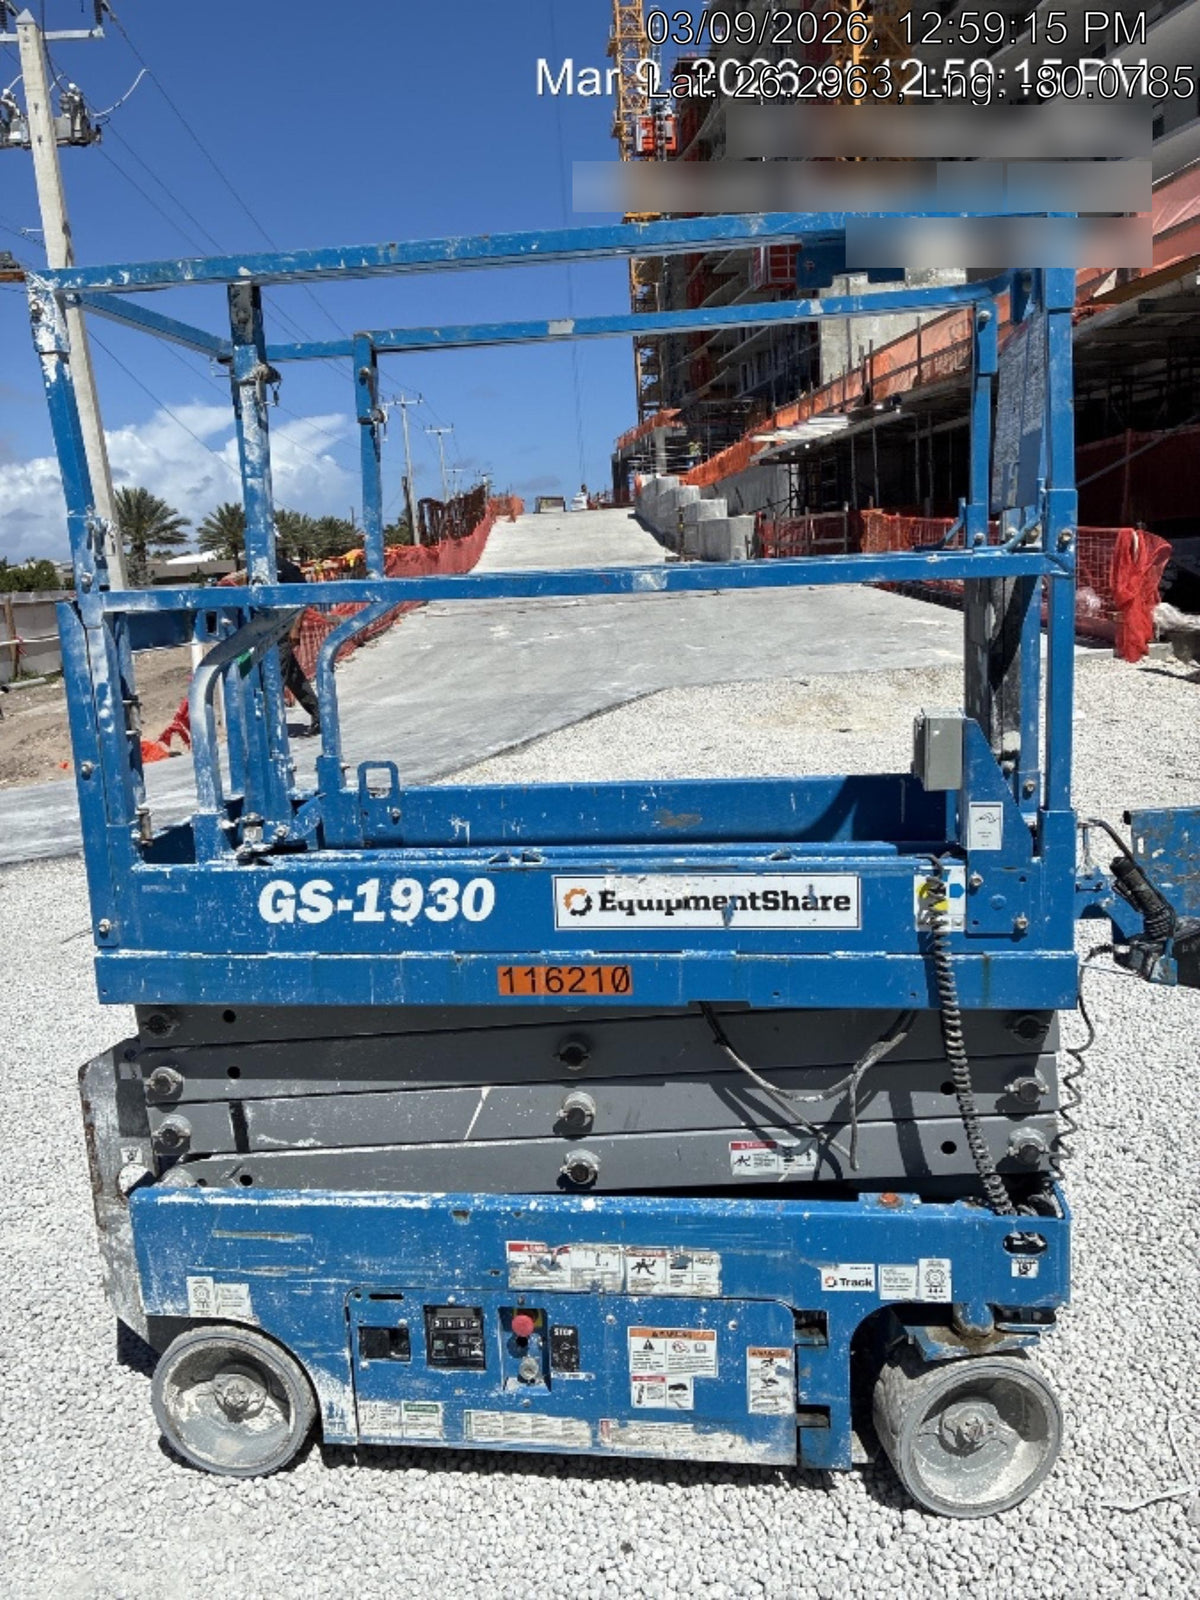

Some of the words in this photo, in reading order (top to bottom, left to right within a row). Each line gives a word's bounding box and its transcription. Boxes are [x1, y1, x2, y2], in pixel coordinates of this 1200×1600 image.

[258, 877, 495, 924] GS-1930
[599, 890, 851, 916] EquipmentShare
[502, 965, 631, 993] 116210
[839, 1277, 873, 1288] Track
[553, 1327, 575, 1336] STOP
